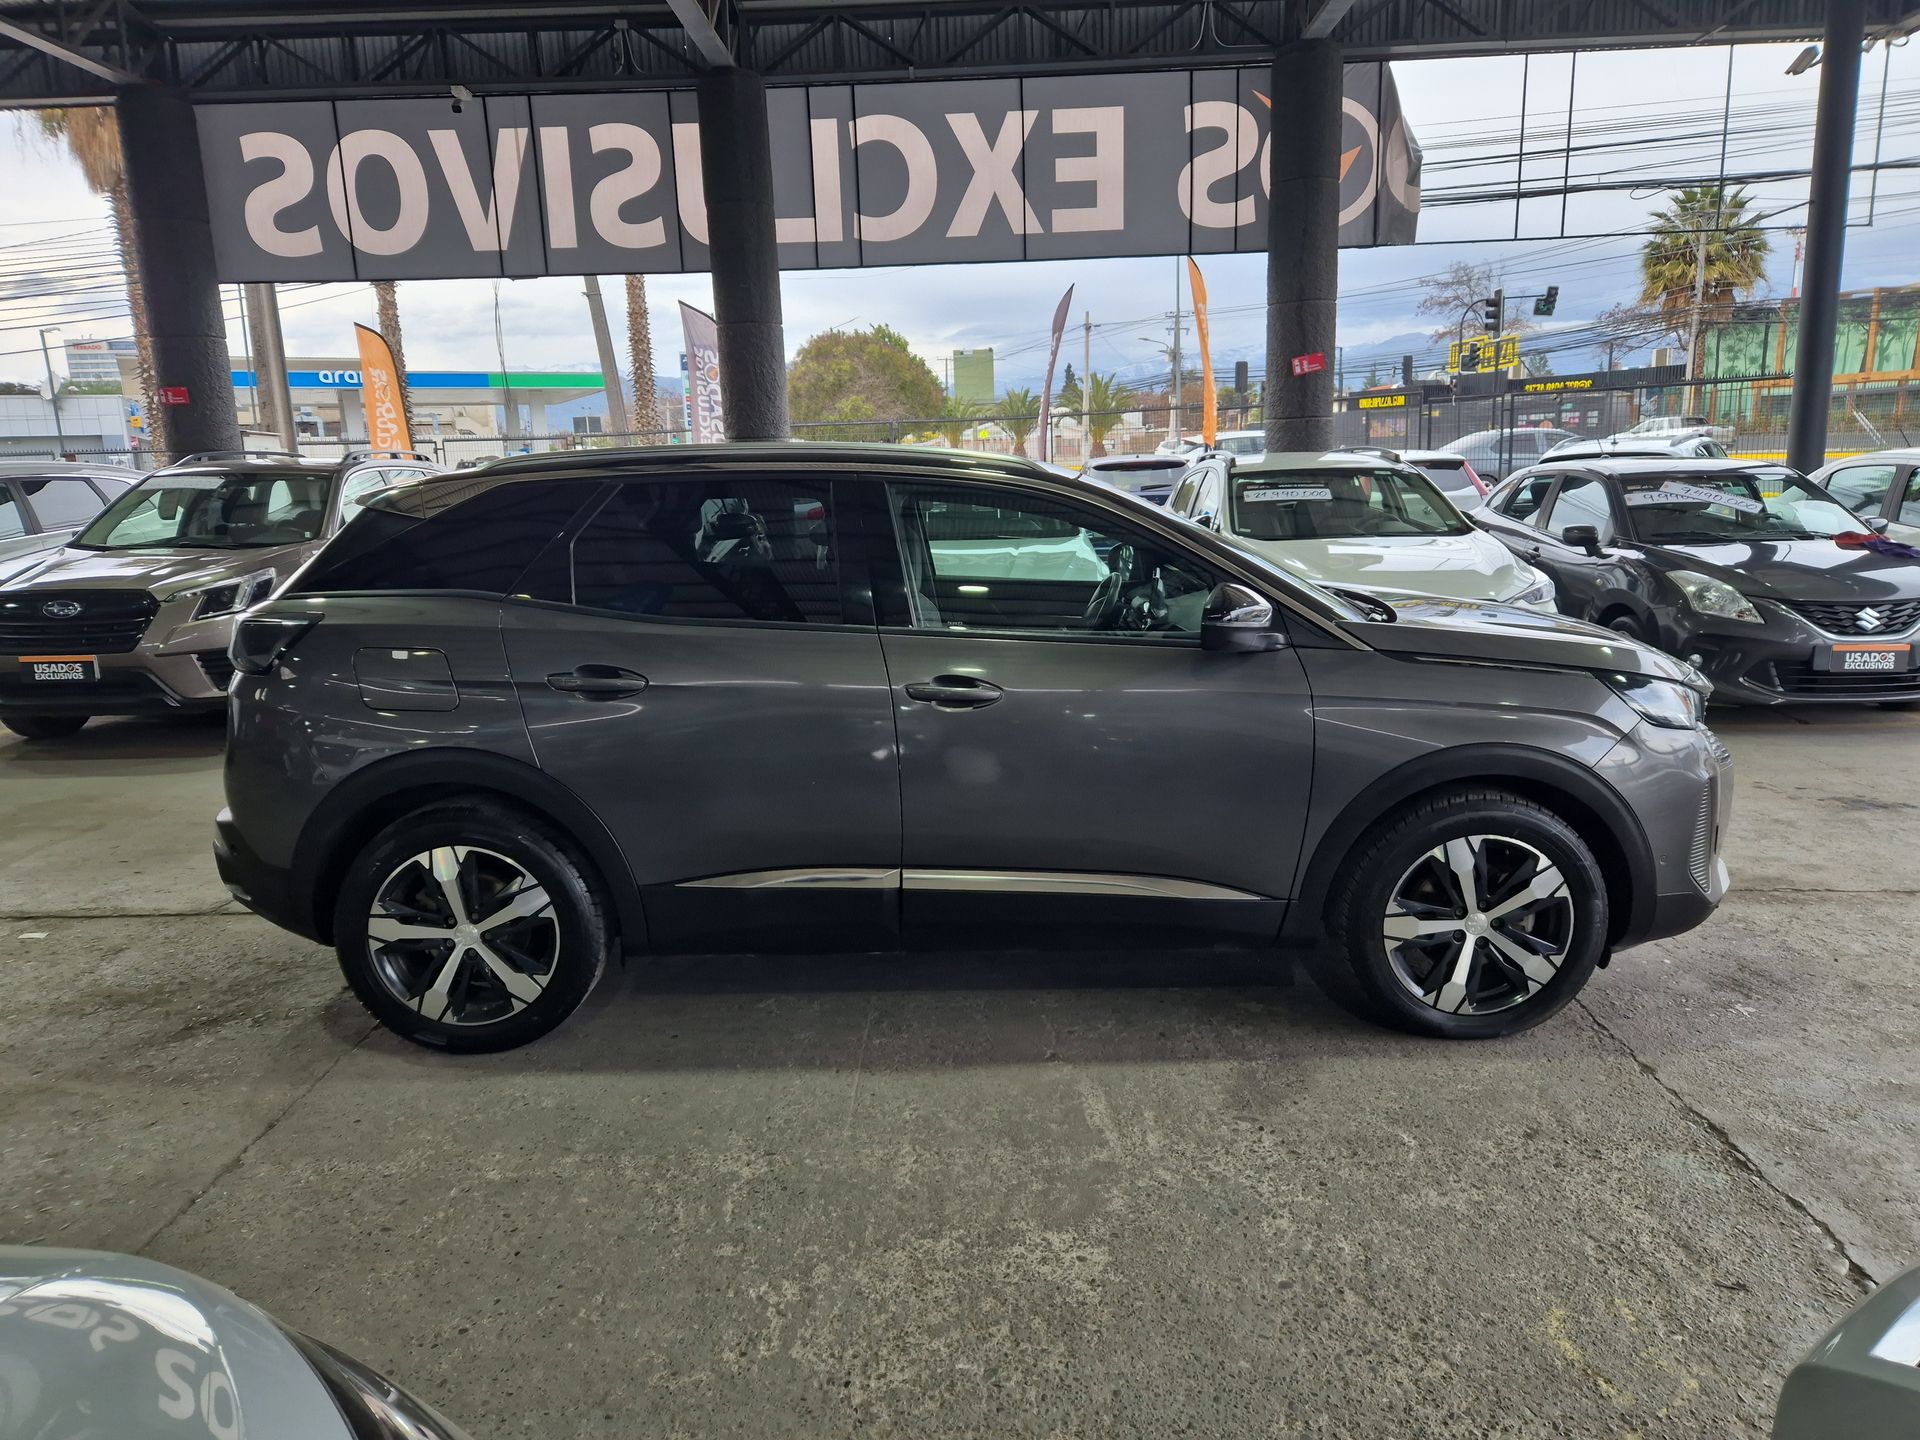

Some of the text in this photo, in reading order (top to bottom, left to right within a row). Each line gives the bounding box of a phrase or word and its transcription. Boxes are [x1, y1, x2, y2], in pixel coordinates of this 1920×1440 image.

[1846, 652, 1895, 662] USADOS
[34, 663, 82, 673] USADOS
[1844, 661, 1894, 670] EXCLUSIVOS
[35, 672, 84, 681] EXCLUSIVOS
